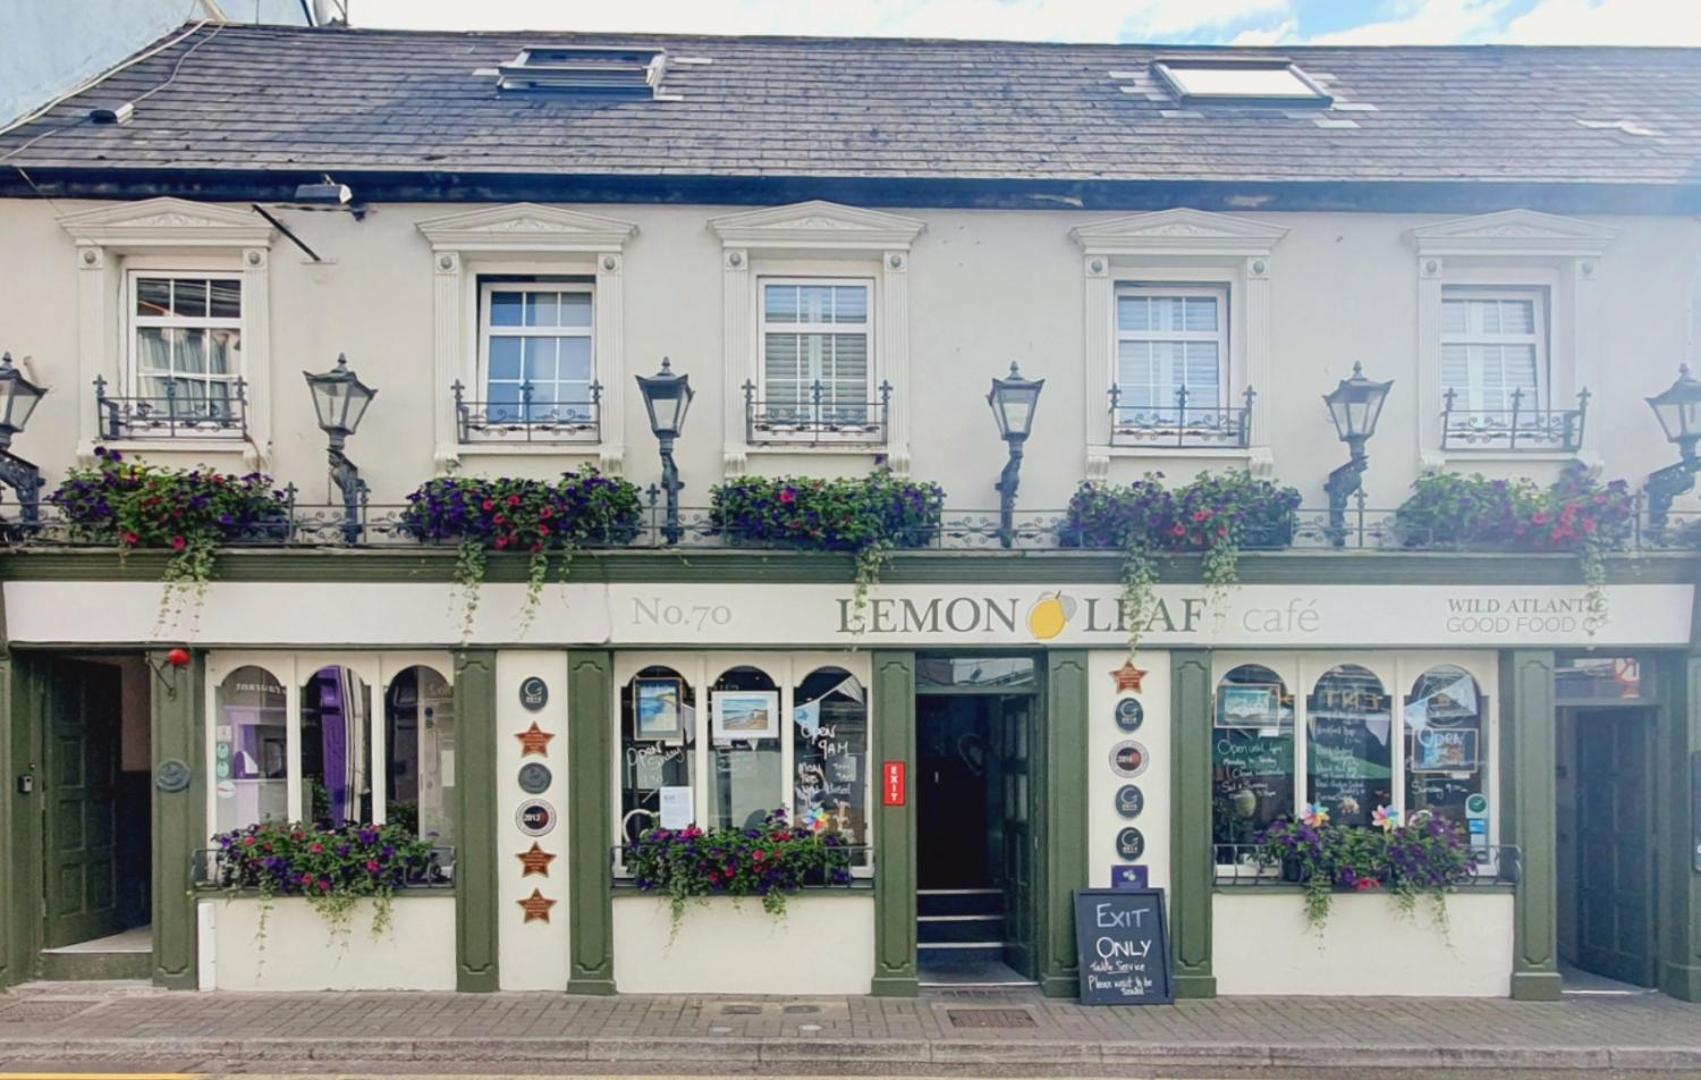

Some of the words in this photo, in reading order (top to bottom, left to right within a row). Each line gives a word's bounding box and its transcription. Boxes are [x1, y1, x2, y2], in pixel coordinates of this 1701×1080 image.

[631, 597, 733, 632] No.70
[835, 596, 1021, 634] LEMON
[1243, 598, 1320, 632] café
[1448, 598, 1501, 613] WILD
[1446, 616, 1510, 632] GOOD
[1515, 616, 1577, 632] FOOD
[890, 766, 899, 802] EXIT
[1096, 903, 1149, 928] EXIT
[1096, 936, 1152, 959] ONLY
